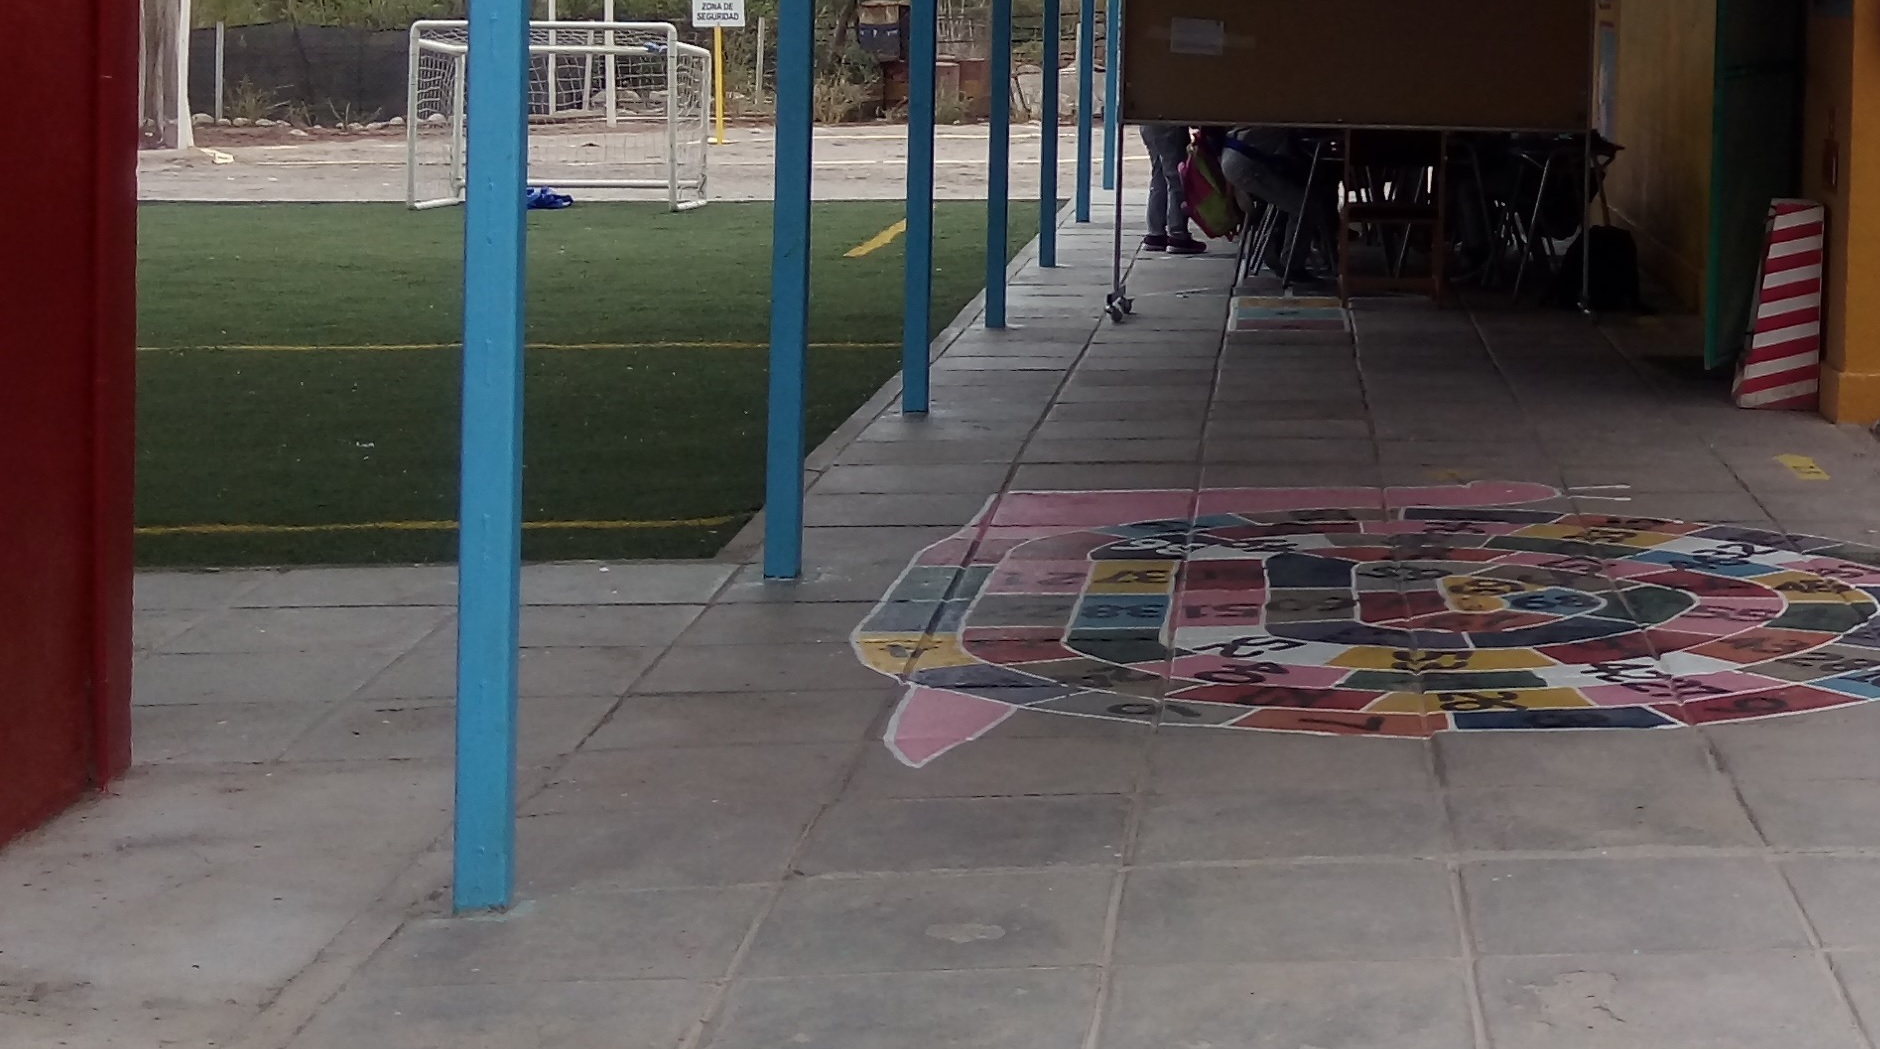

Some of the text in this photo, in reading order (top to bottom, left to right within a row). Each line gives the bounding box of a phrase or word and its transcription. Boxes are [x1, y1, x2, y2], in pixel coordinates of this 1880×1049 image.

[701, 2, 734, 11] ZONA DE
[696, 12, 740, 21] SEGURIDAD
